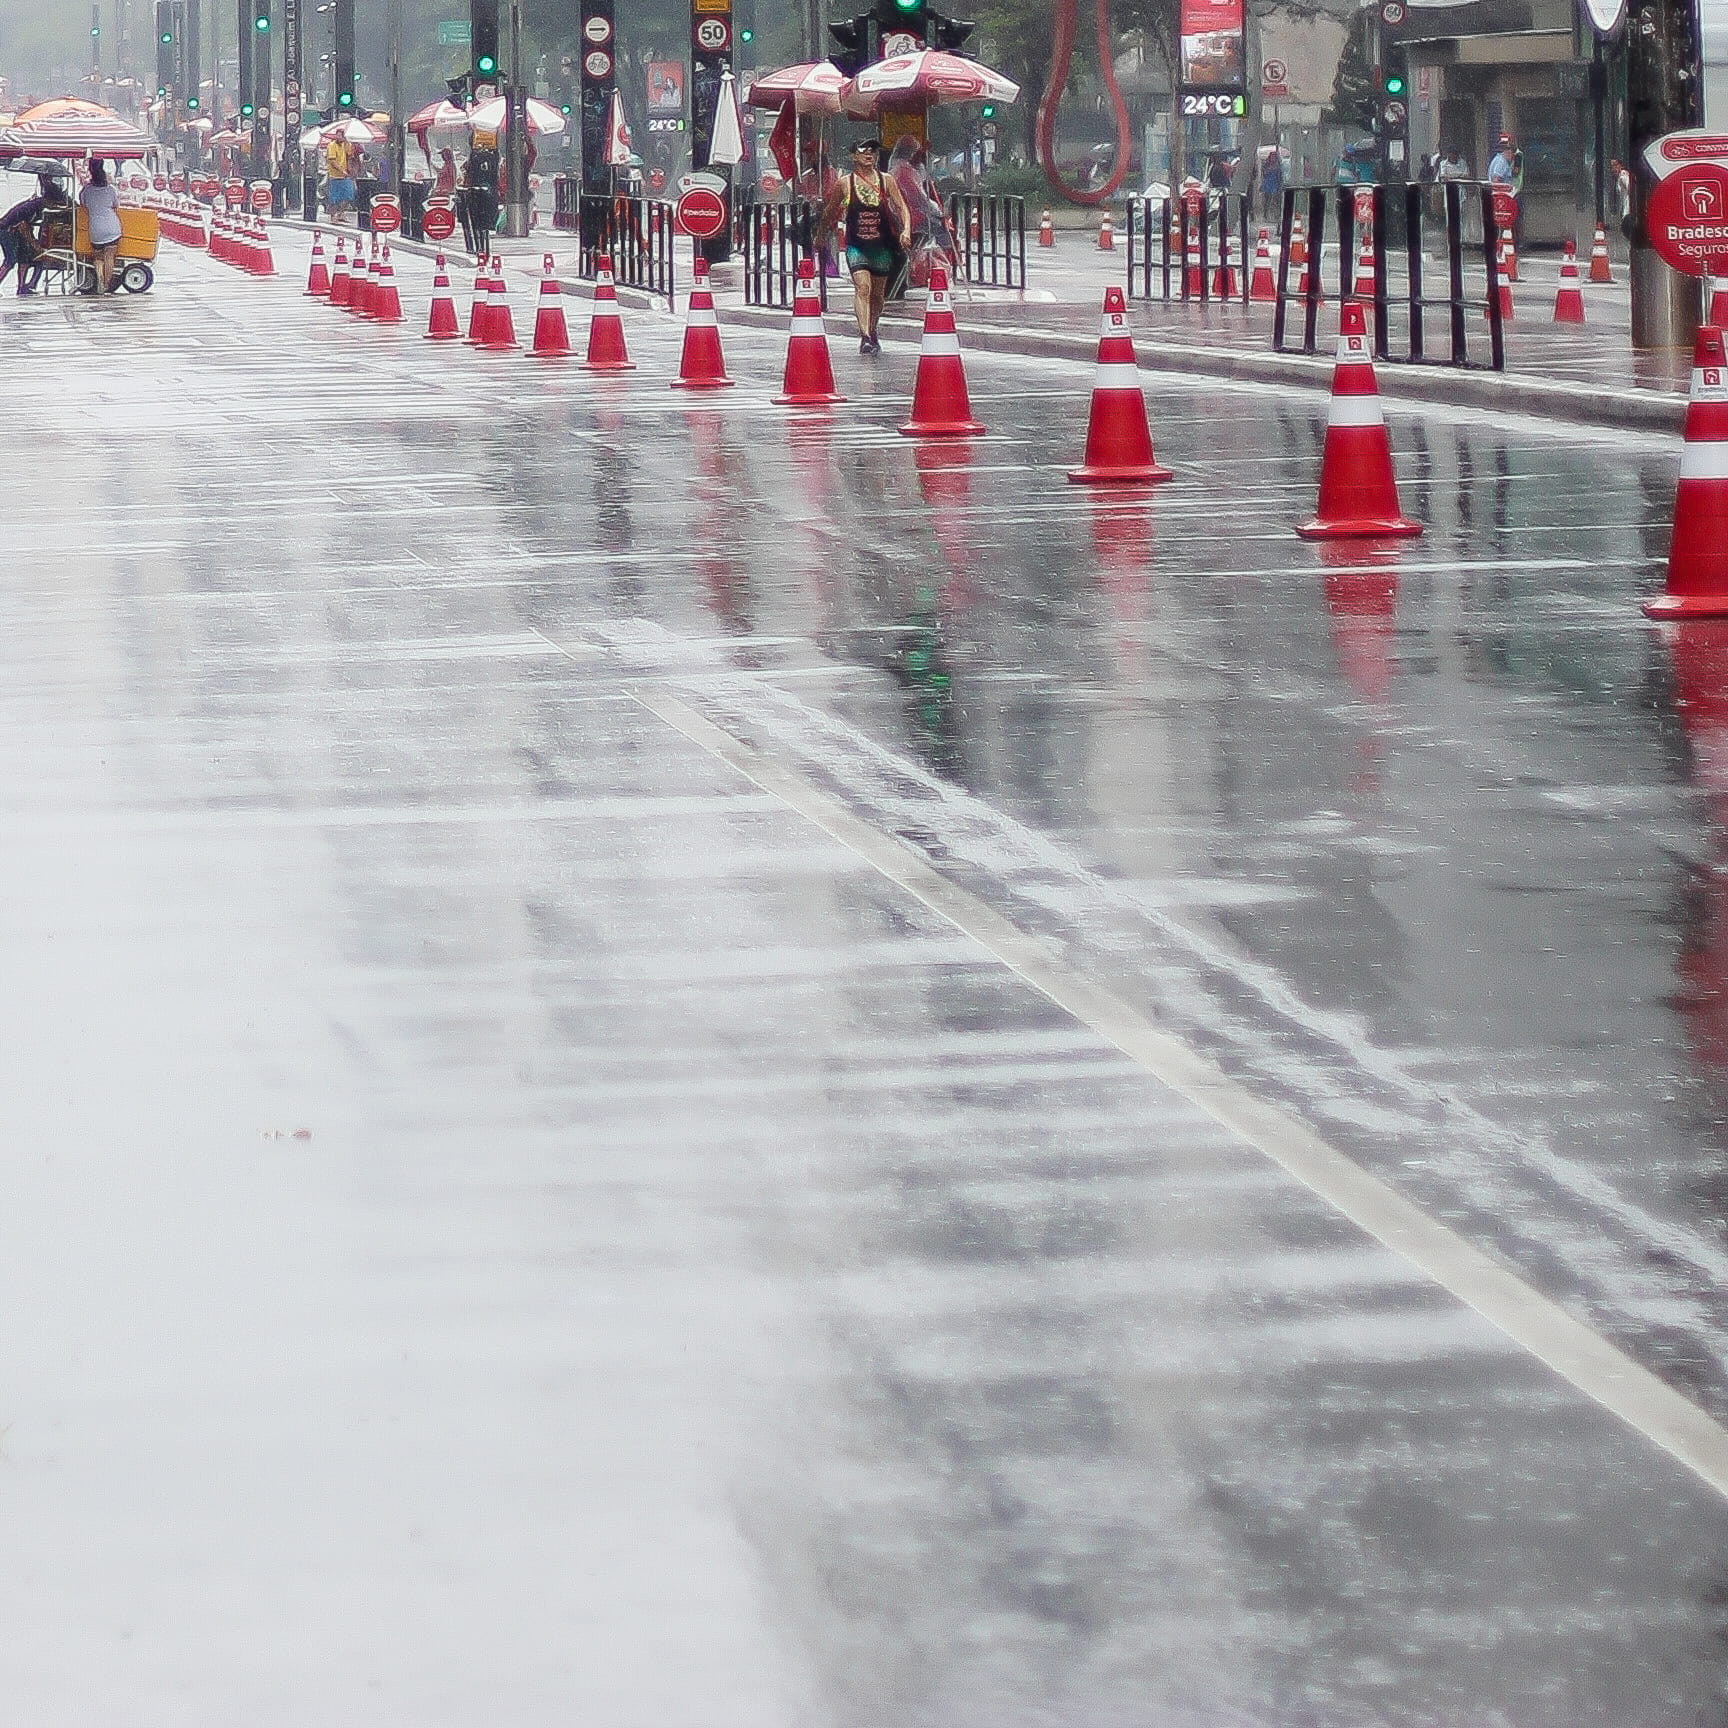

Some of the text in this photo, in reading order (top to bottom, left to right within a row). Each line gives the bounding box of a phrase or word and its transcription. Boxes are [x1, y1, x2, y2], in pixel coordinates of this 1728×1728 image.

[701, 25, 724, 41] 50
[1184, 95, 1232, 115] 24°C
[649, 119, 677, 132] 24°C
